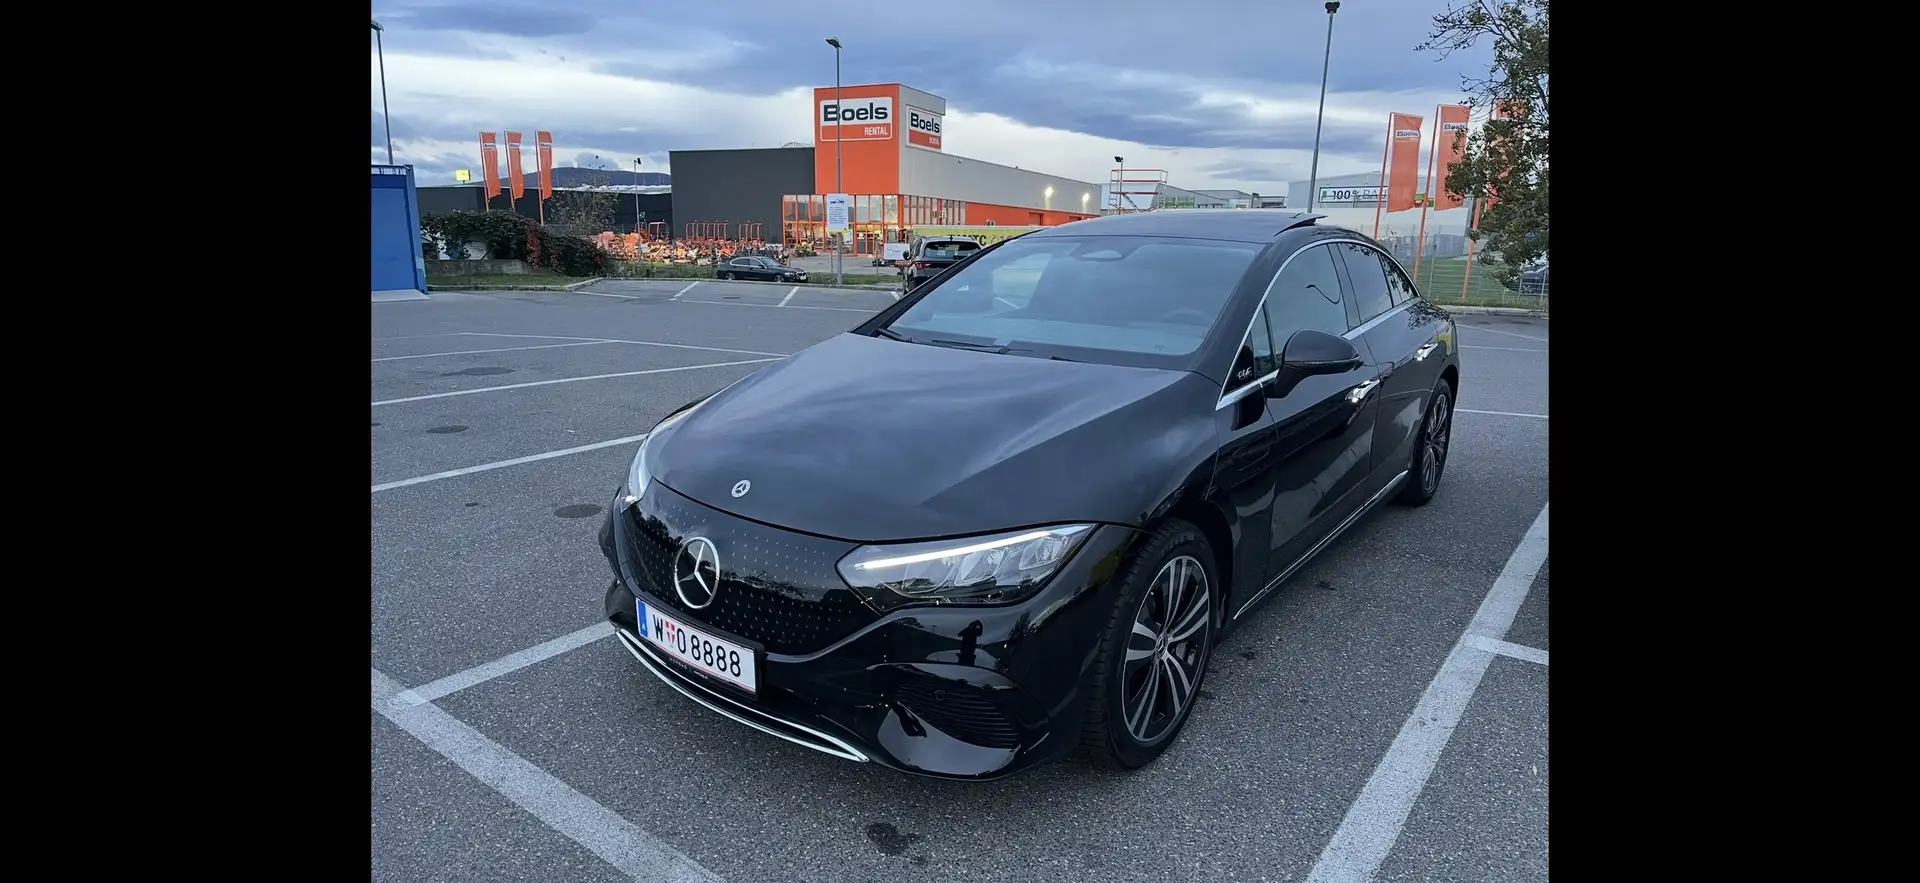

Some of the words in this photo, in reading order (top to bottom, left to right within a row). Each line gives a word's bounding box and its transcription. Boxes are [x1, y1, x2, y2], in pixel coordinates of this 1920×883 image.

[823, 102, 888, 121] Boels
[864, 126, 888, 135] RENTAL
[910, 112, 940, 133] Boels
